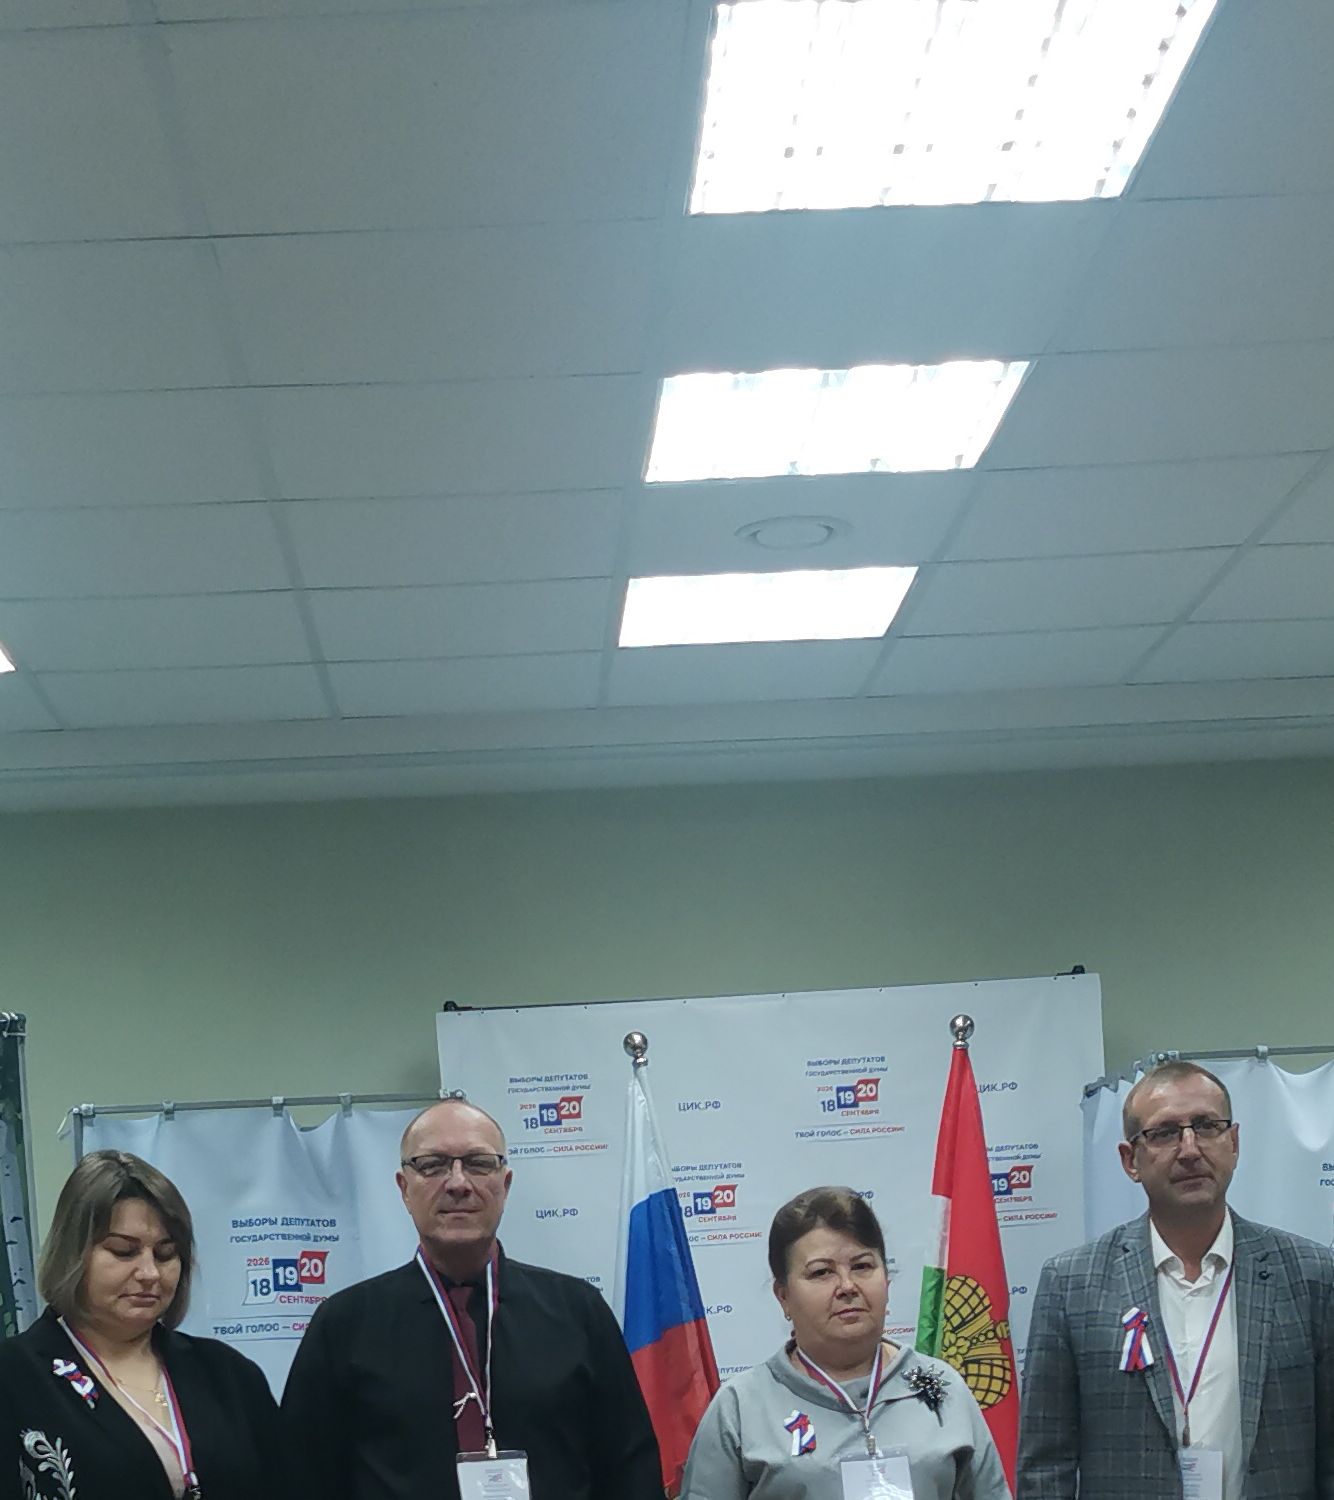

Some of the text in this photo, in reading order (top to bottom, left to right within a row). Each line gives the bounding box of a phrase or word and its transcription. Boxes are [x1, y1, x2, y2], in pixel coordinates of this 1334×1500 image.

[544, 1074, 589, 1082] ДЕПУТАТОВ
[820, 1083, 877, 1113] 18 19 20
[678, 1101, 721, 1112] ЦИК.РФ
[523, 1100, 580, 1130] 18 19 20
[992, 1171, 1030, 1191] 19 20
[683, 1189, 734, 1218] 8 19 20
[535, 1208, 579, 1219] ЦИК.РФ
[231, 1217, 337, 1228] ВЫБОРЫ ДЕПУТАТОВ
[229, 1232, 340, 1243] ГОСУДАРСТВЕННОЙ ДУМЫ
[707, 1233, 728, 1241] СИЛА
[246, 1257, 270, 1267] 2026
[250, 1258, 324, 1297] 18 19 20
[706, 1304, 733, 1315] К.РФ
[212, 1324, 243, 1335] ТВОЙ
[245, 1323, 279, 1333] ГОЛОС
